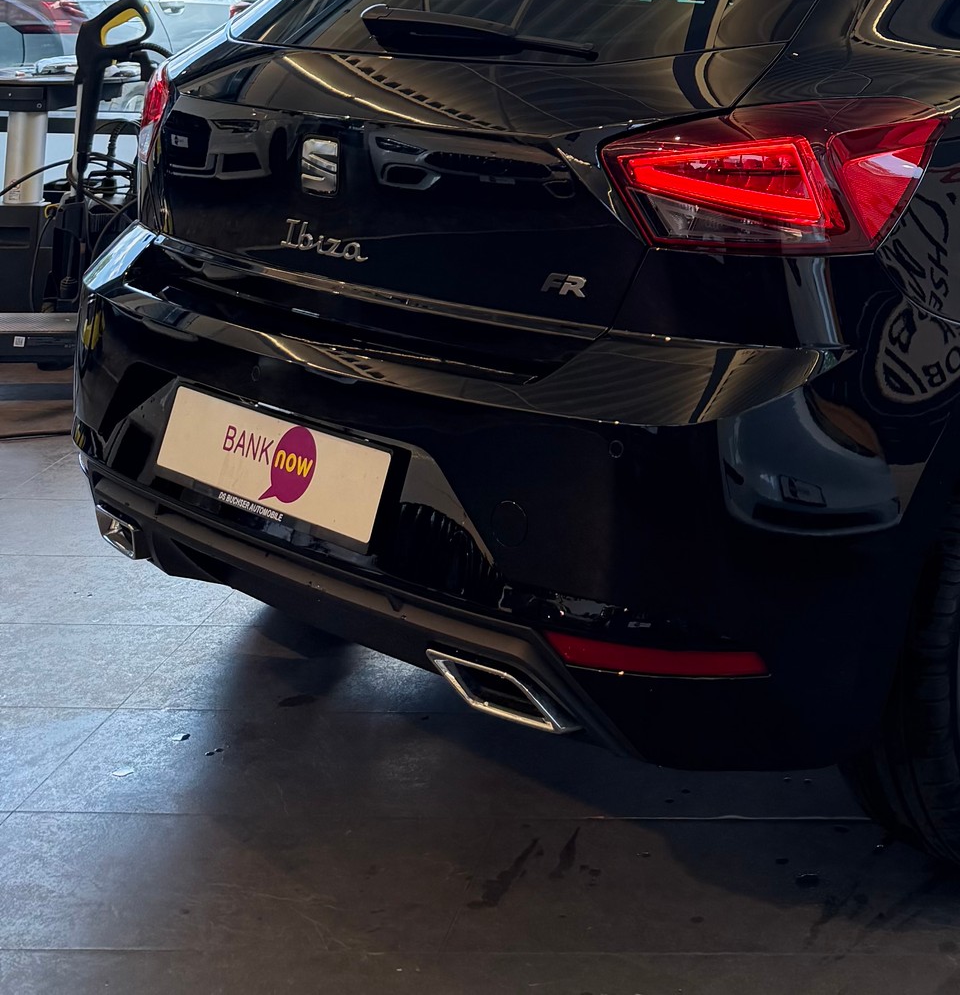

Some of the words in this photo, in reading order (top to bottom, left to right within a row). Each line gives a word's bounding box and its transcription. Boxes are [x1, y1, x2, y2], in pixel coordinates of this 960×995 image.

[280, 218, 369, 263] Ibiza
[540, 272, 588, 299] FR
[222, 425, 275, 466] BANK
[274, 449, 314, 478] now
[217, 491, 227, 501] DS
[225, 494, 251, 510] BUCHSER
[249, 503, 284, 522] AUTOMOBILE
